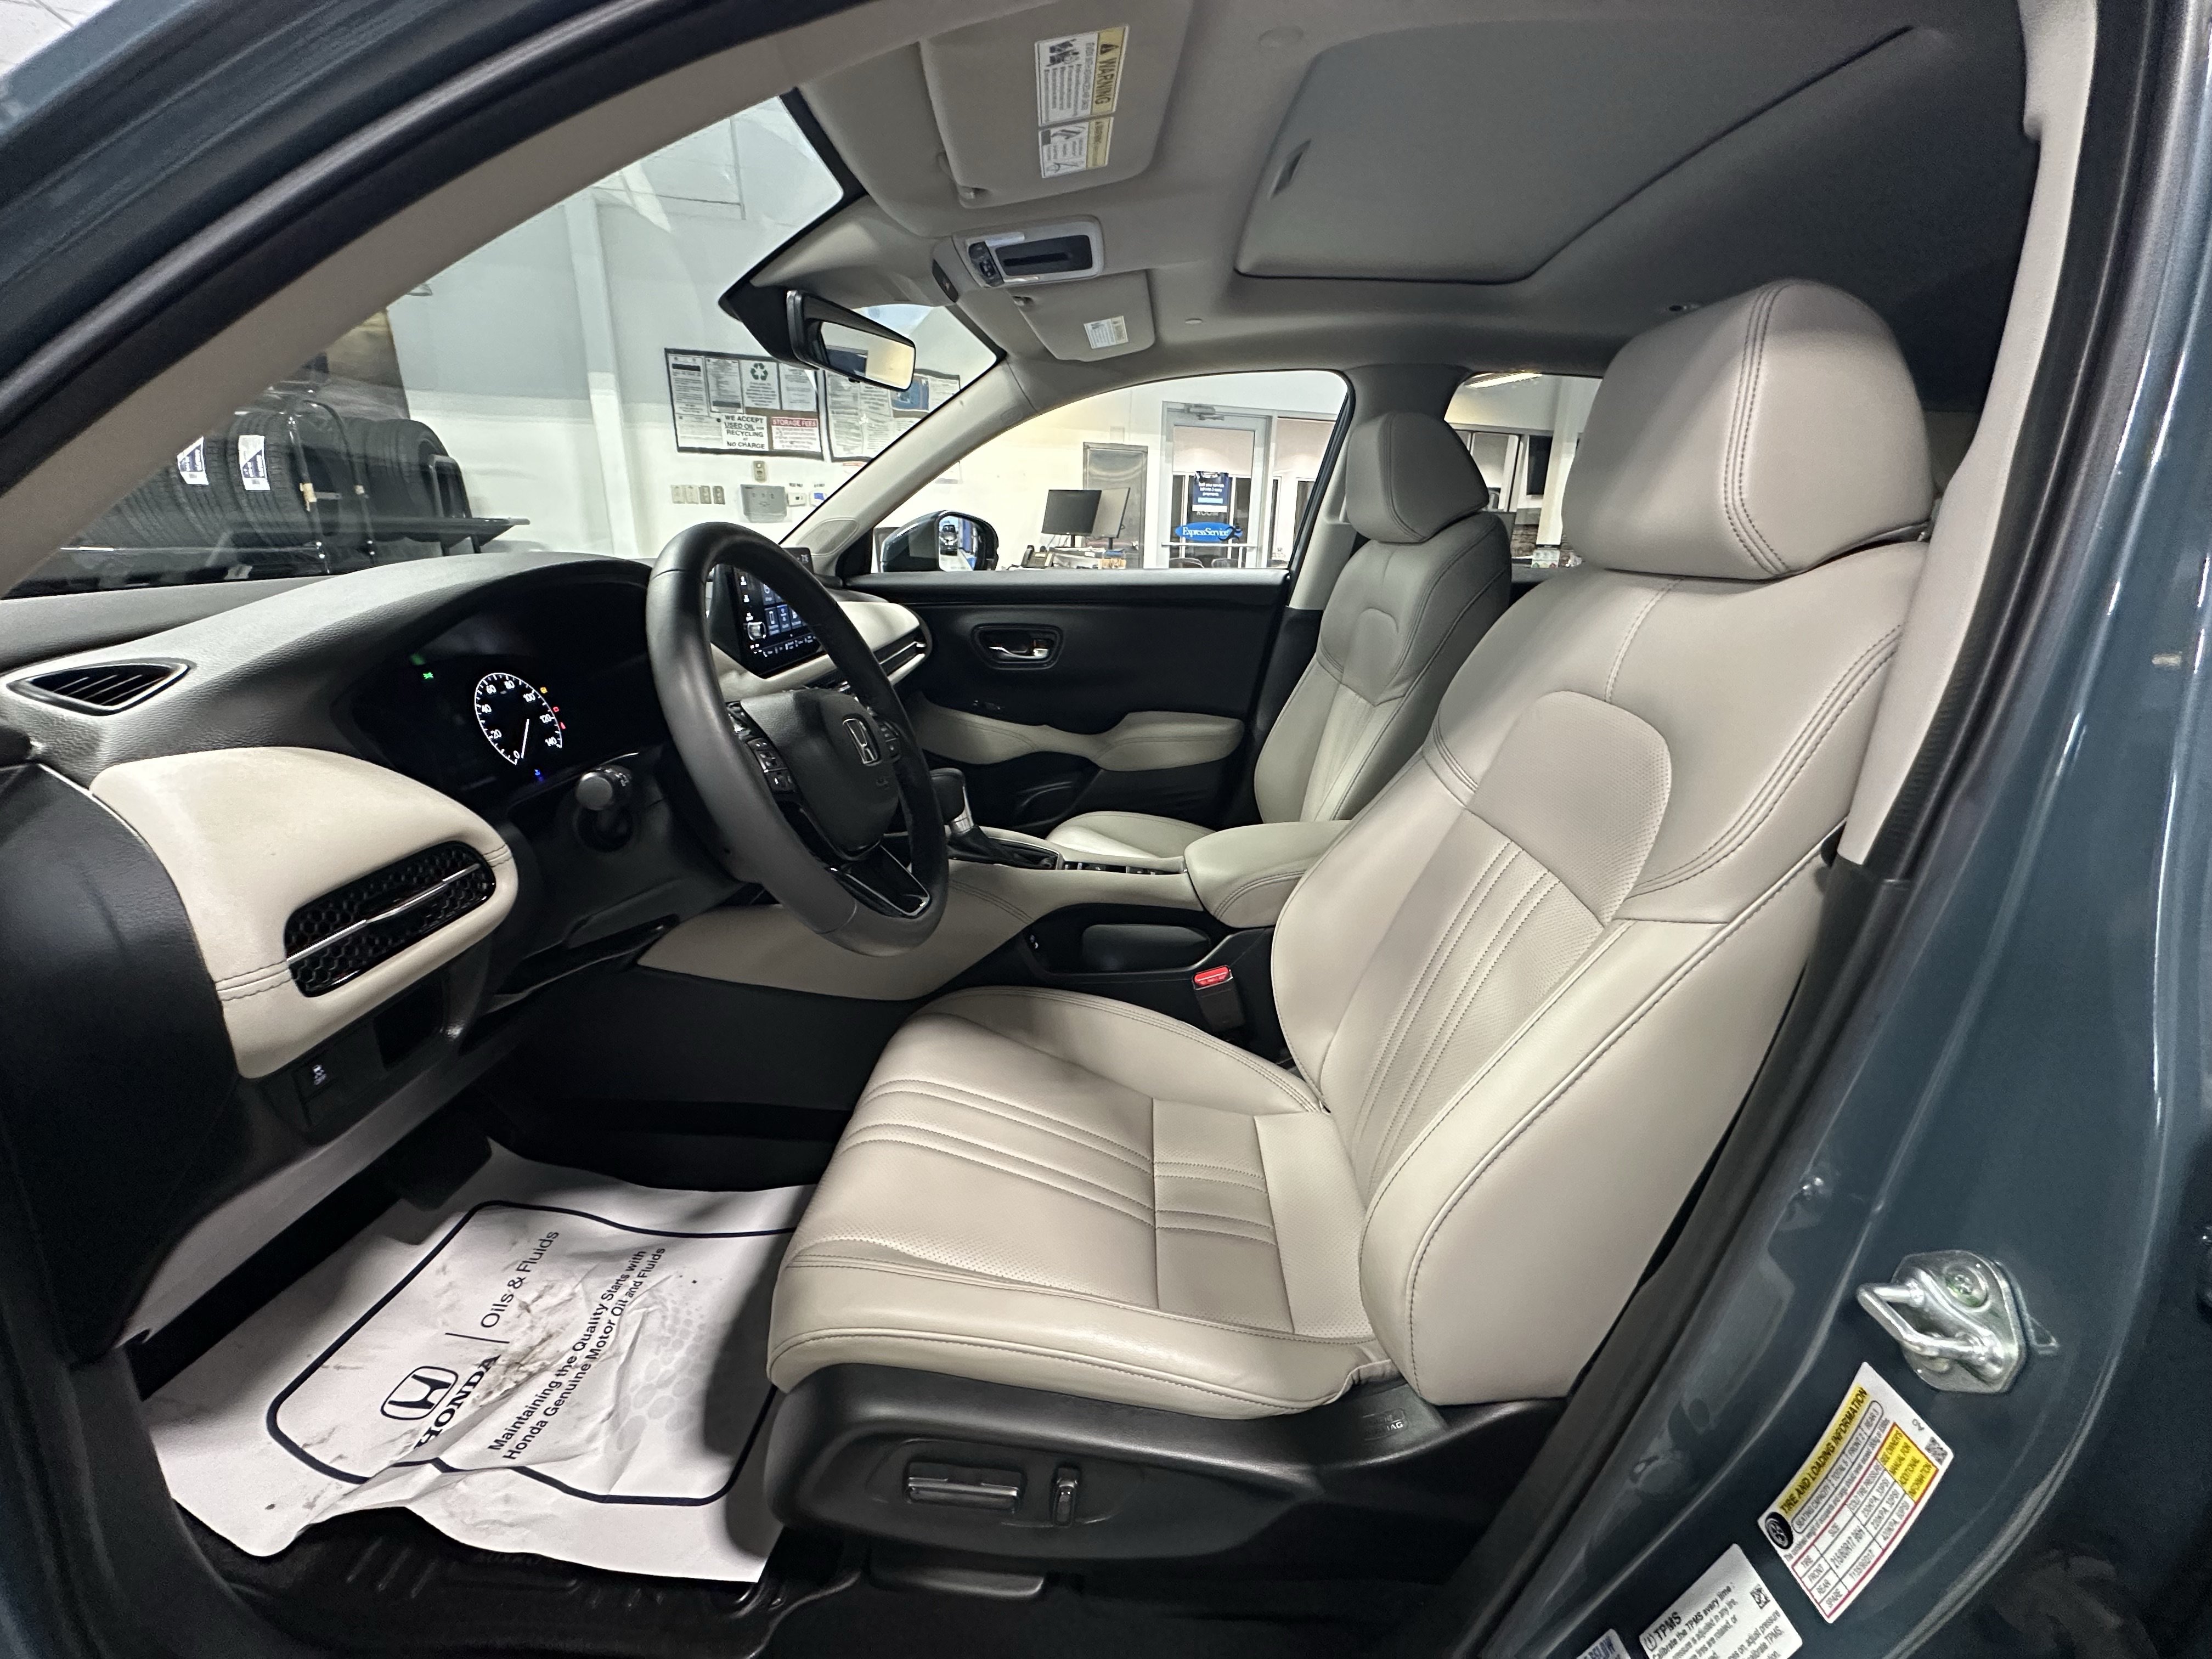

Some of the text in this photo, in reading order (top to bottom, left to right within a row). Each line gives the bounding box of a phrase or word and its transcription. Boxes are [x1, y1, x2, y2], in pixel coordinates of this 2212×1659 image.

[1094, 57, 1117, 104] WARNING
[486, 685, 496, 694] 60
[504, 680, 515, 689] 80
[523, 693, 535, 702] 100
[540, 714, 552, 723] 120
[490, 729, 502, 739] 20
[514, 751, 520, 759] 0
[481, 1231, 560, 1329] Oils & Fluids
[488, 1250, 647, 1451] Maintaining the Quality Starts with
[503, 1247, 666, 1460] Honda Genuine Motor Oil and Fluids
[414, 1355, 501, 1449] HONDA
[1781, 1386, 1866, 1514] TIRE AND LOADING INFORMATION
[1808, 1562, 1825, 1584] FRONT
[1817, 1578, 1831, 1596] REAR
[1826, 1587, 1842, 1608] SPARE
[1677, 1629, 1688, 1642] the
[1685, 1612, 1703, 1630] TPMS
[1703, 1597, 1719, 1616] every
[1717, 1585, 1731, 1600] time
[1759, 1610, 1781, 1635] pressure
[1655, 1612, 1682, 1641] TPMS
